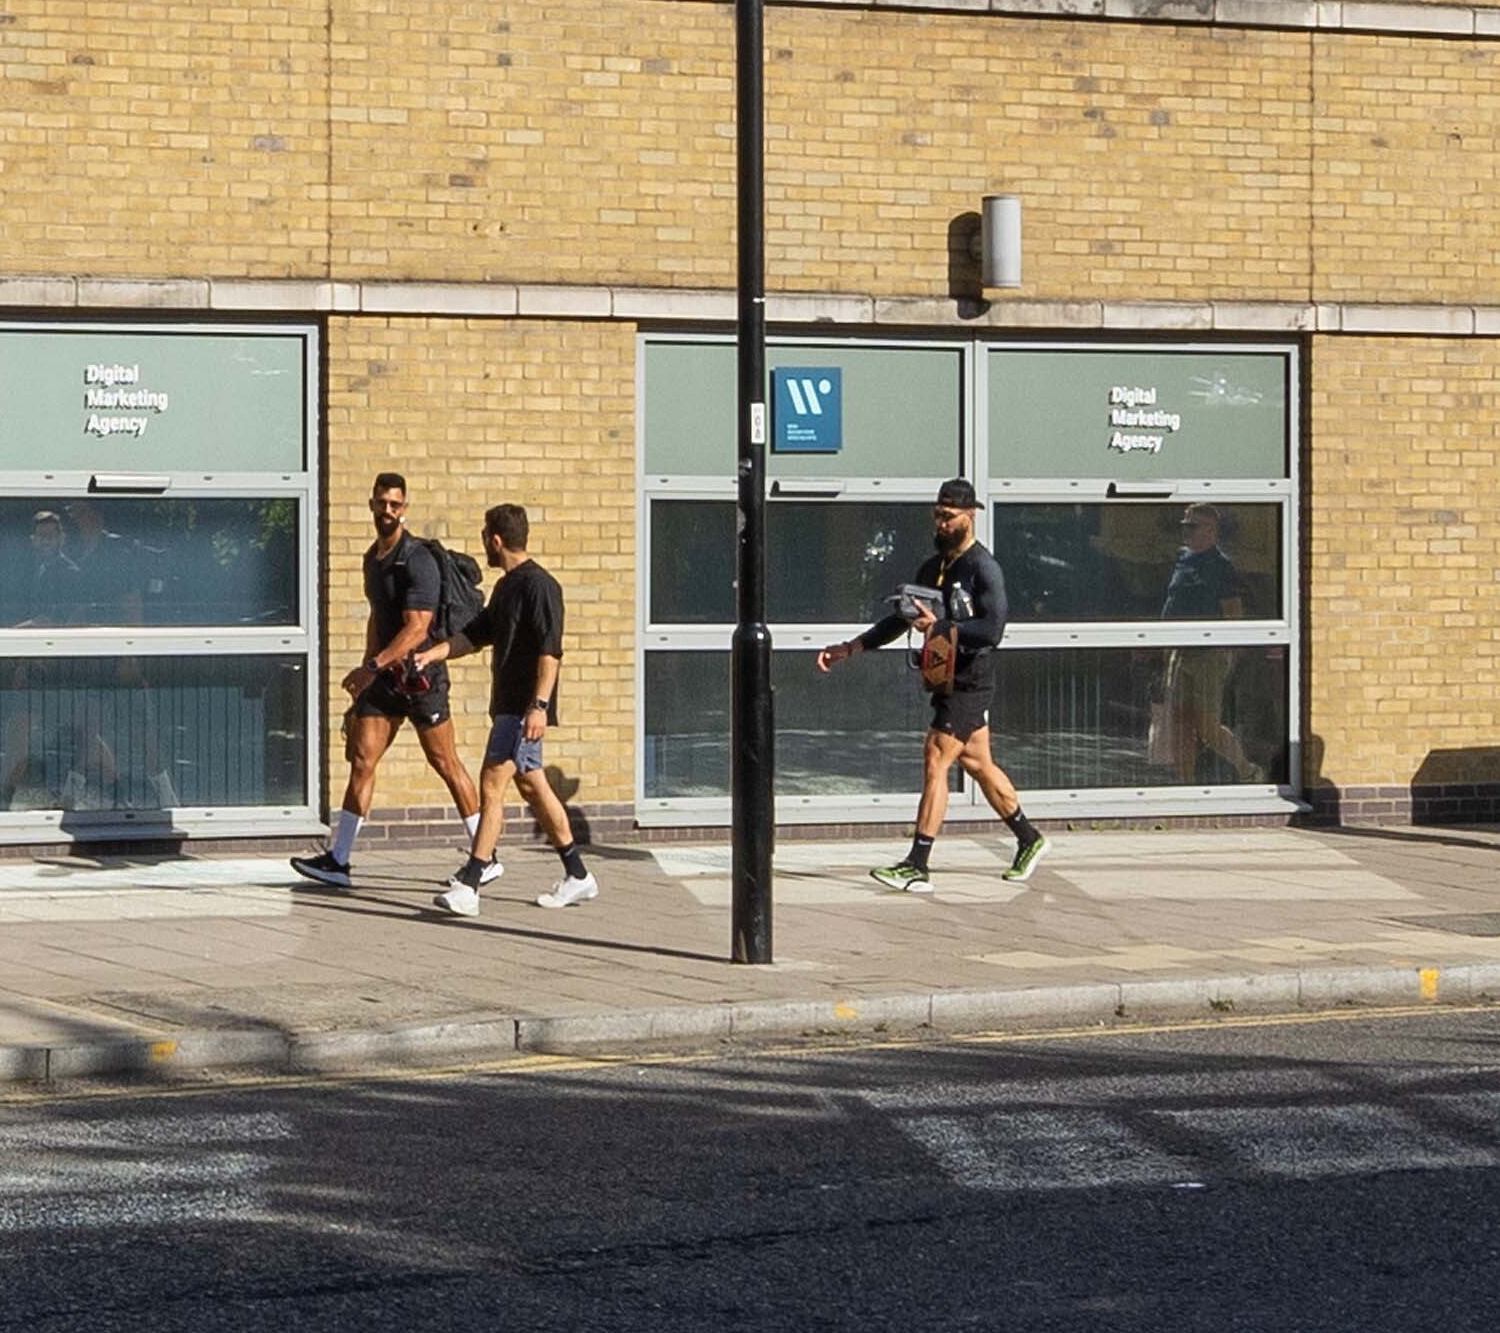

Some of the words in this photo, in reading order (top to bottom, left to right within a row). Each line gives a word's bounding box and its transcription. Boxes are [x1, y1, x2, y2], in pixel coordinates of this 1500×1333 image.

[87, 364, 139, 386] Digital
[87, 388, 168, 411] Marketing
[1112, 387, 1156, 407] Digital
[87, 414, 148, 435] Agency
[1112, 409, 1180, 431] Marketing
[1112, 431, 1163, 452] Agency
